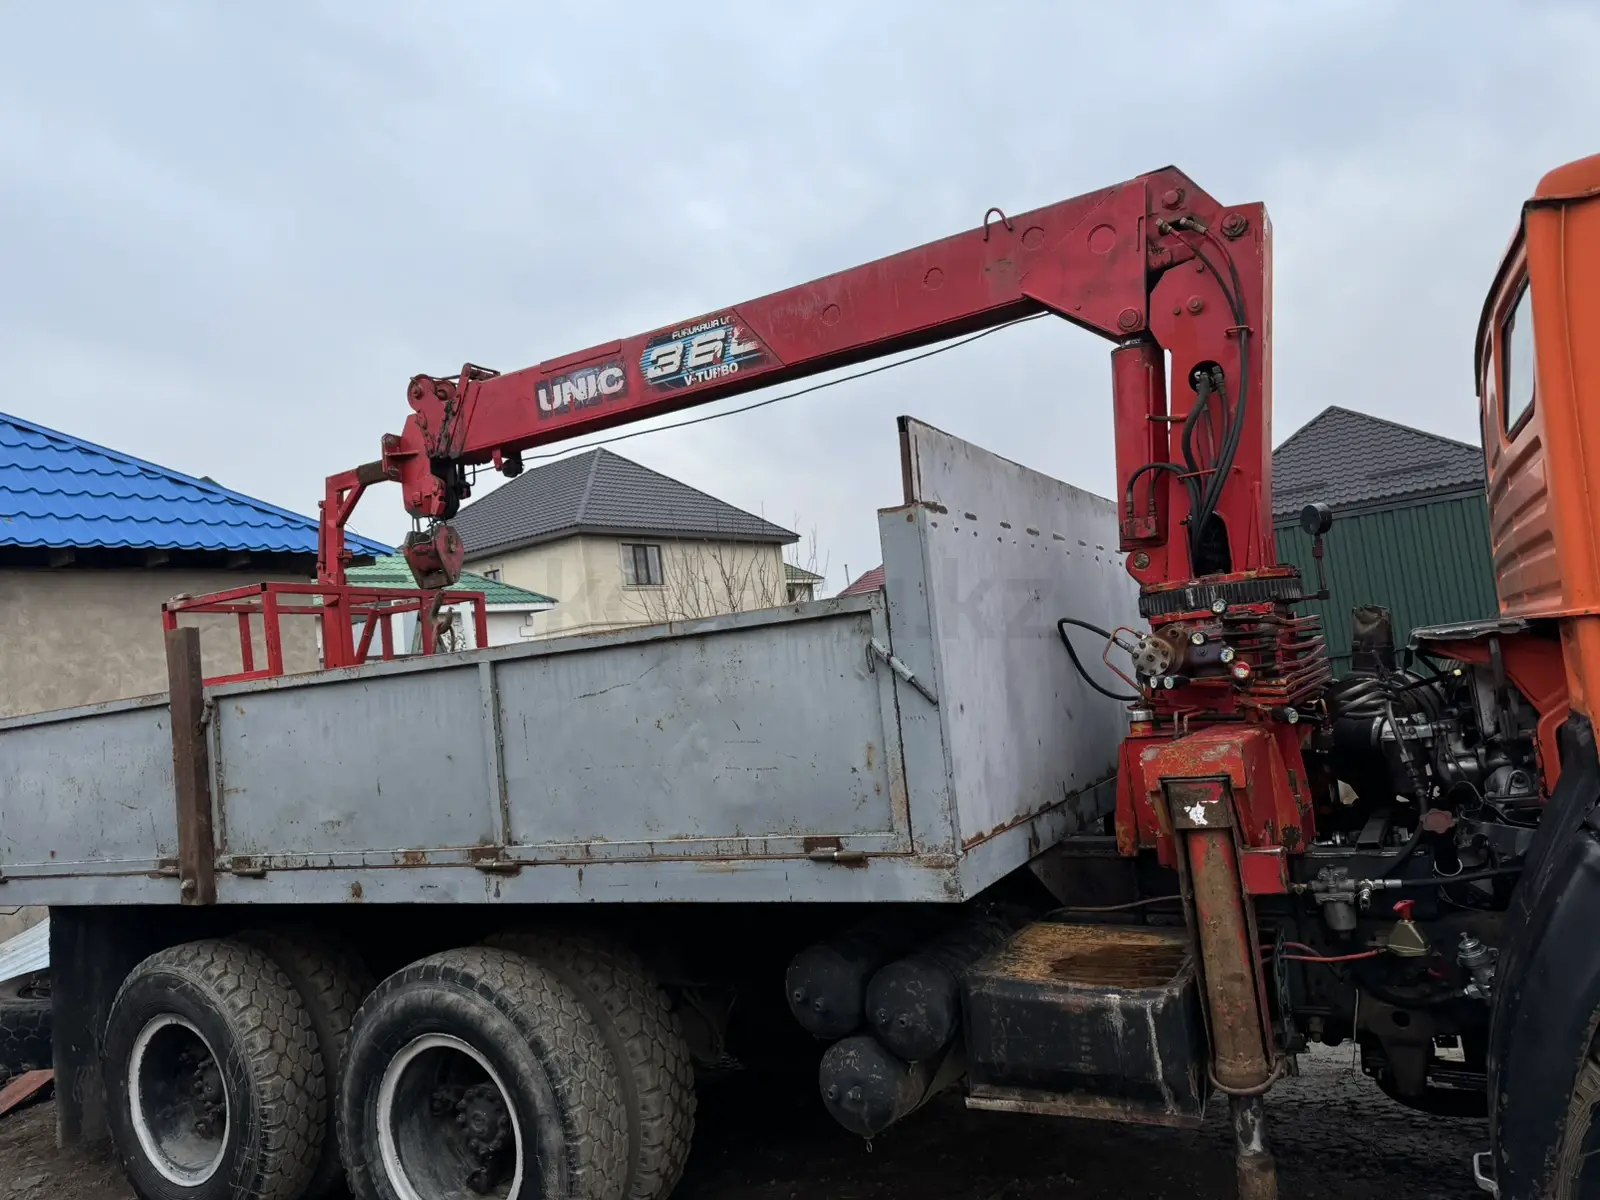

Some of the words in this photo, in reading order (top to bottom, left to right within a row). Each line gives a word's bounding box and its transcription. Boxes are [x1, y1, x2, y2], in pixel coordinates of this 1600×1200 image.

[672, 319, 719, 340] FURUKAWA
[684, 363, 739, 386] V-TURBO
[537, 366, 624, 411] UNIC
